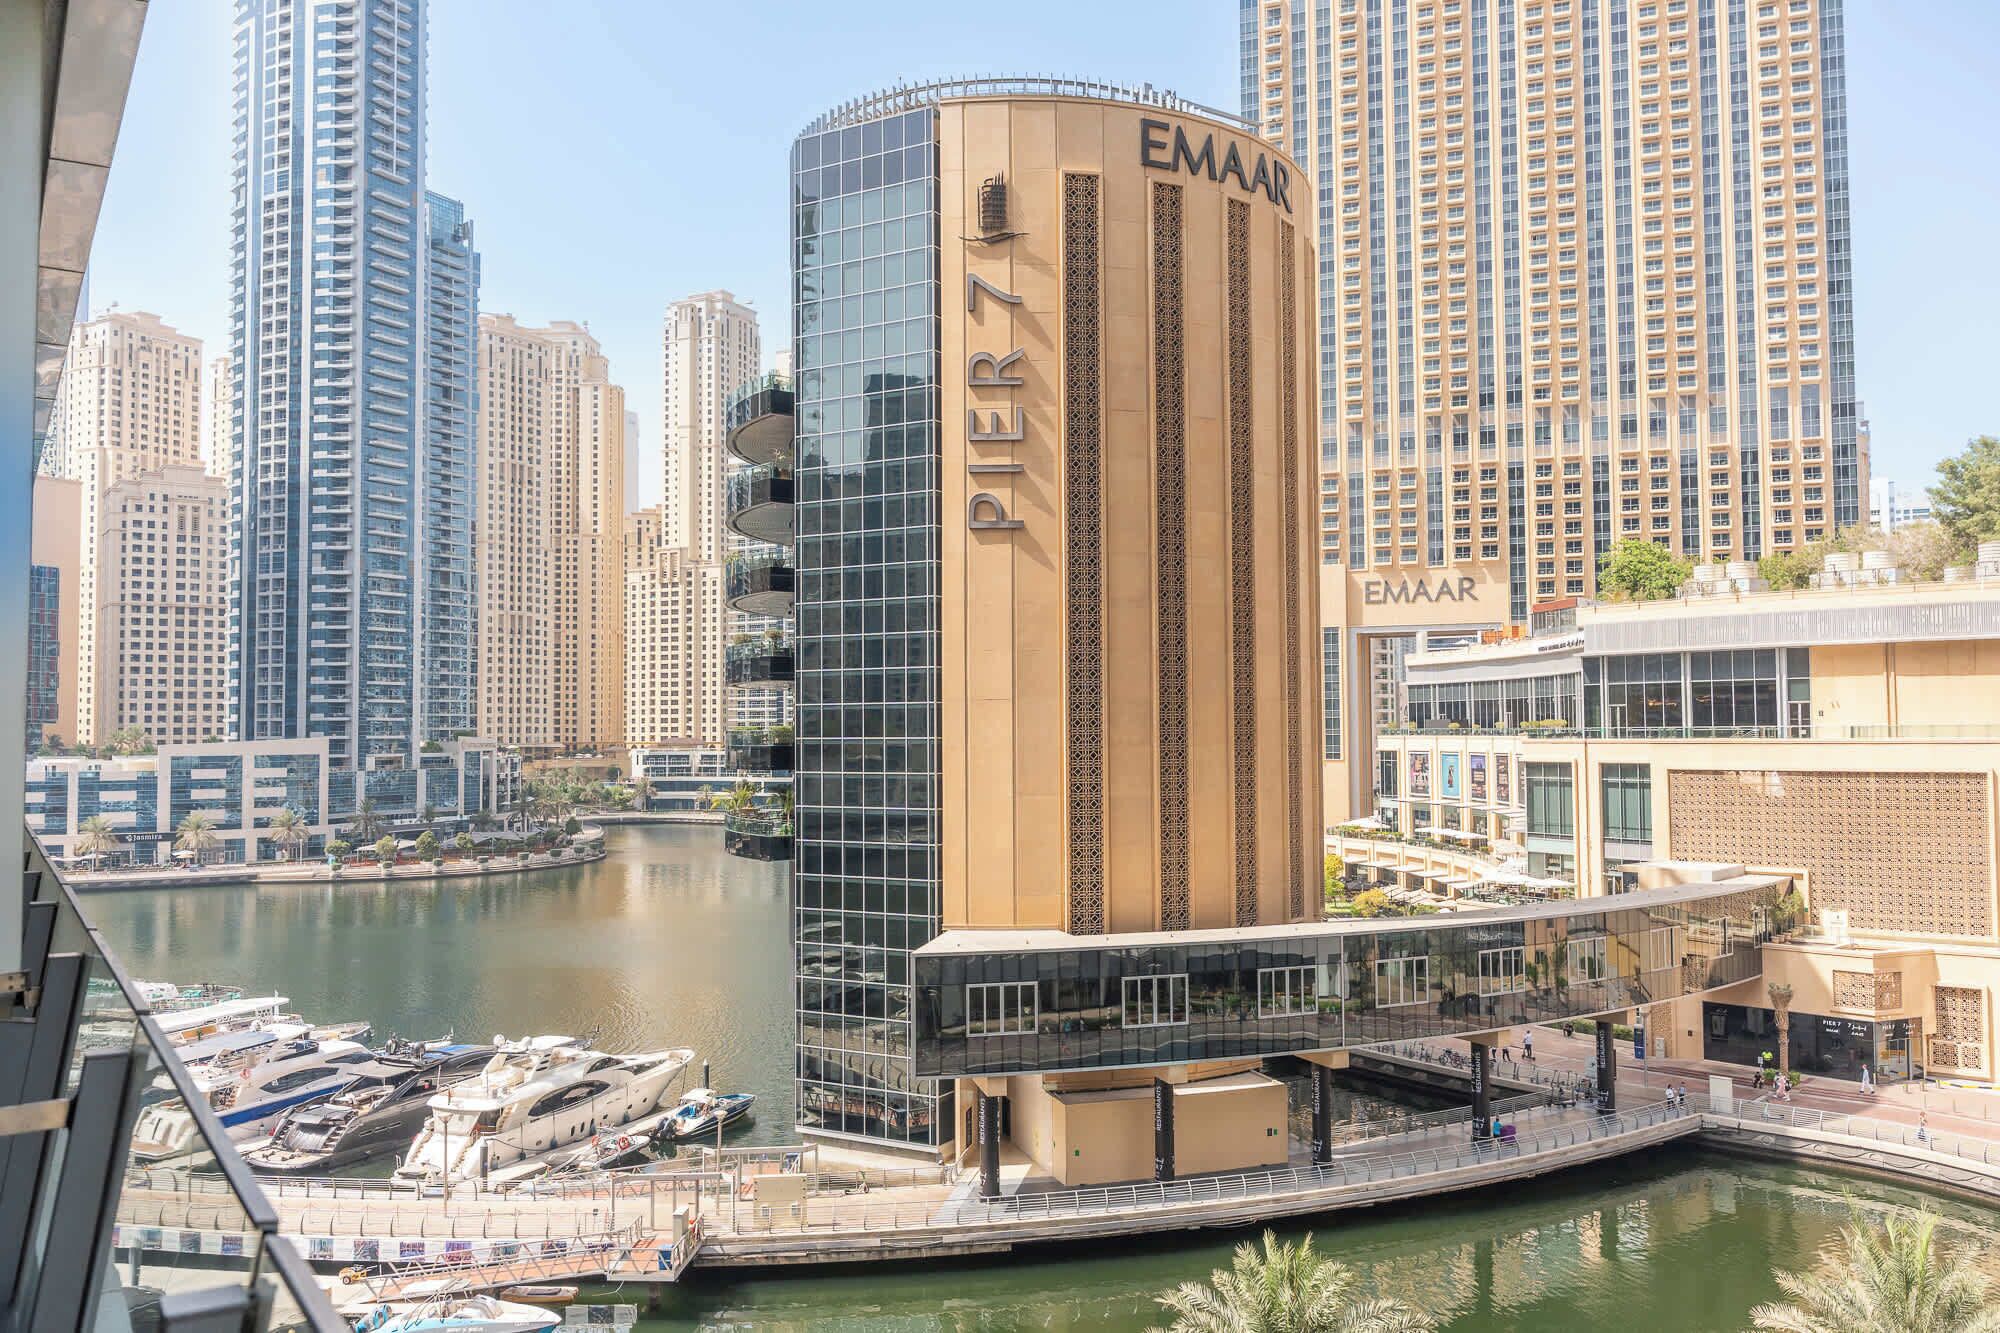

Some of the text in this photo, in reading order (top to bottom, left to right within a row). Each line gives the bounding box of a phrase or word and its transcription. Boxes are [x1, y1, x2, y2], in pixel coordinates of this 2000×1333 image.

[1141, 118, 1293, 214] EMAAR
[967, 272, 1024, 528] PIER 7
[1365, 577, 1479, 604] EMAAR
